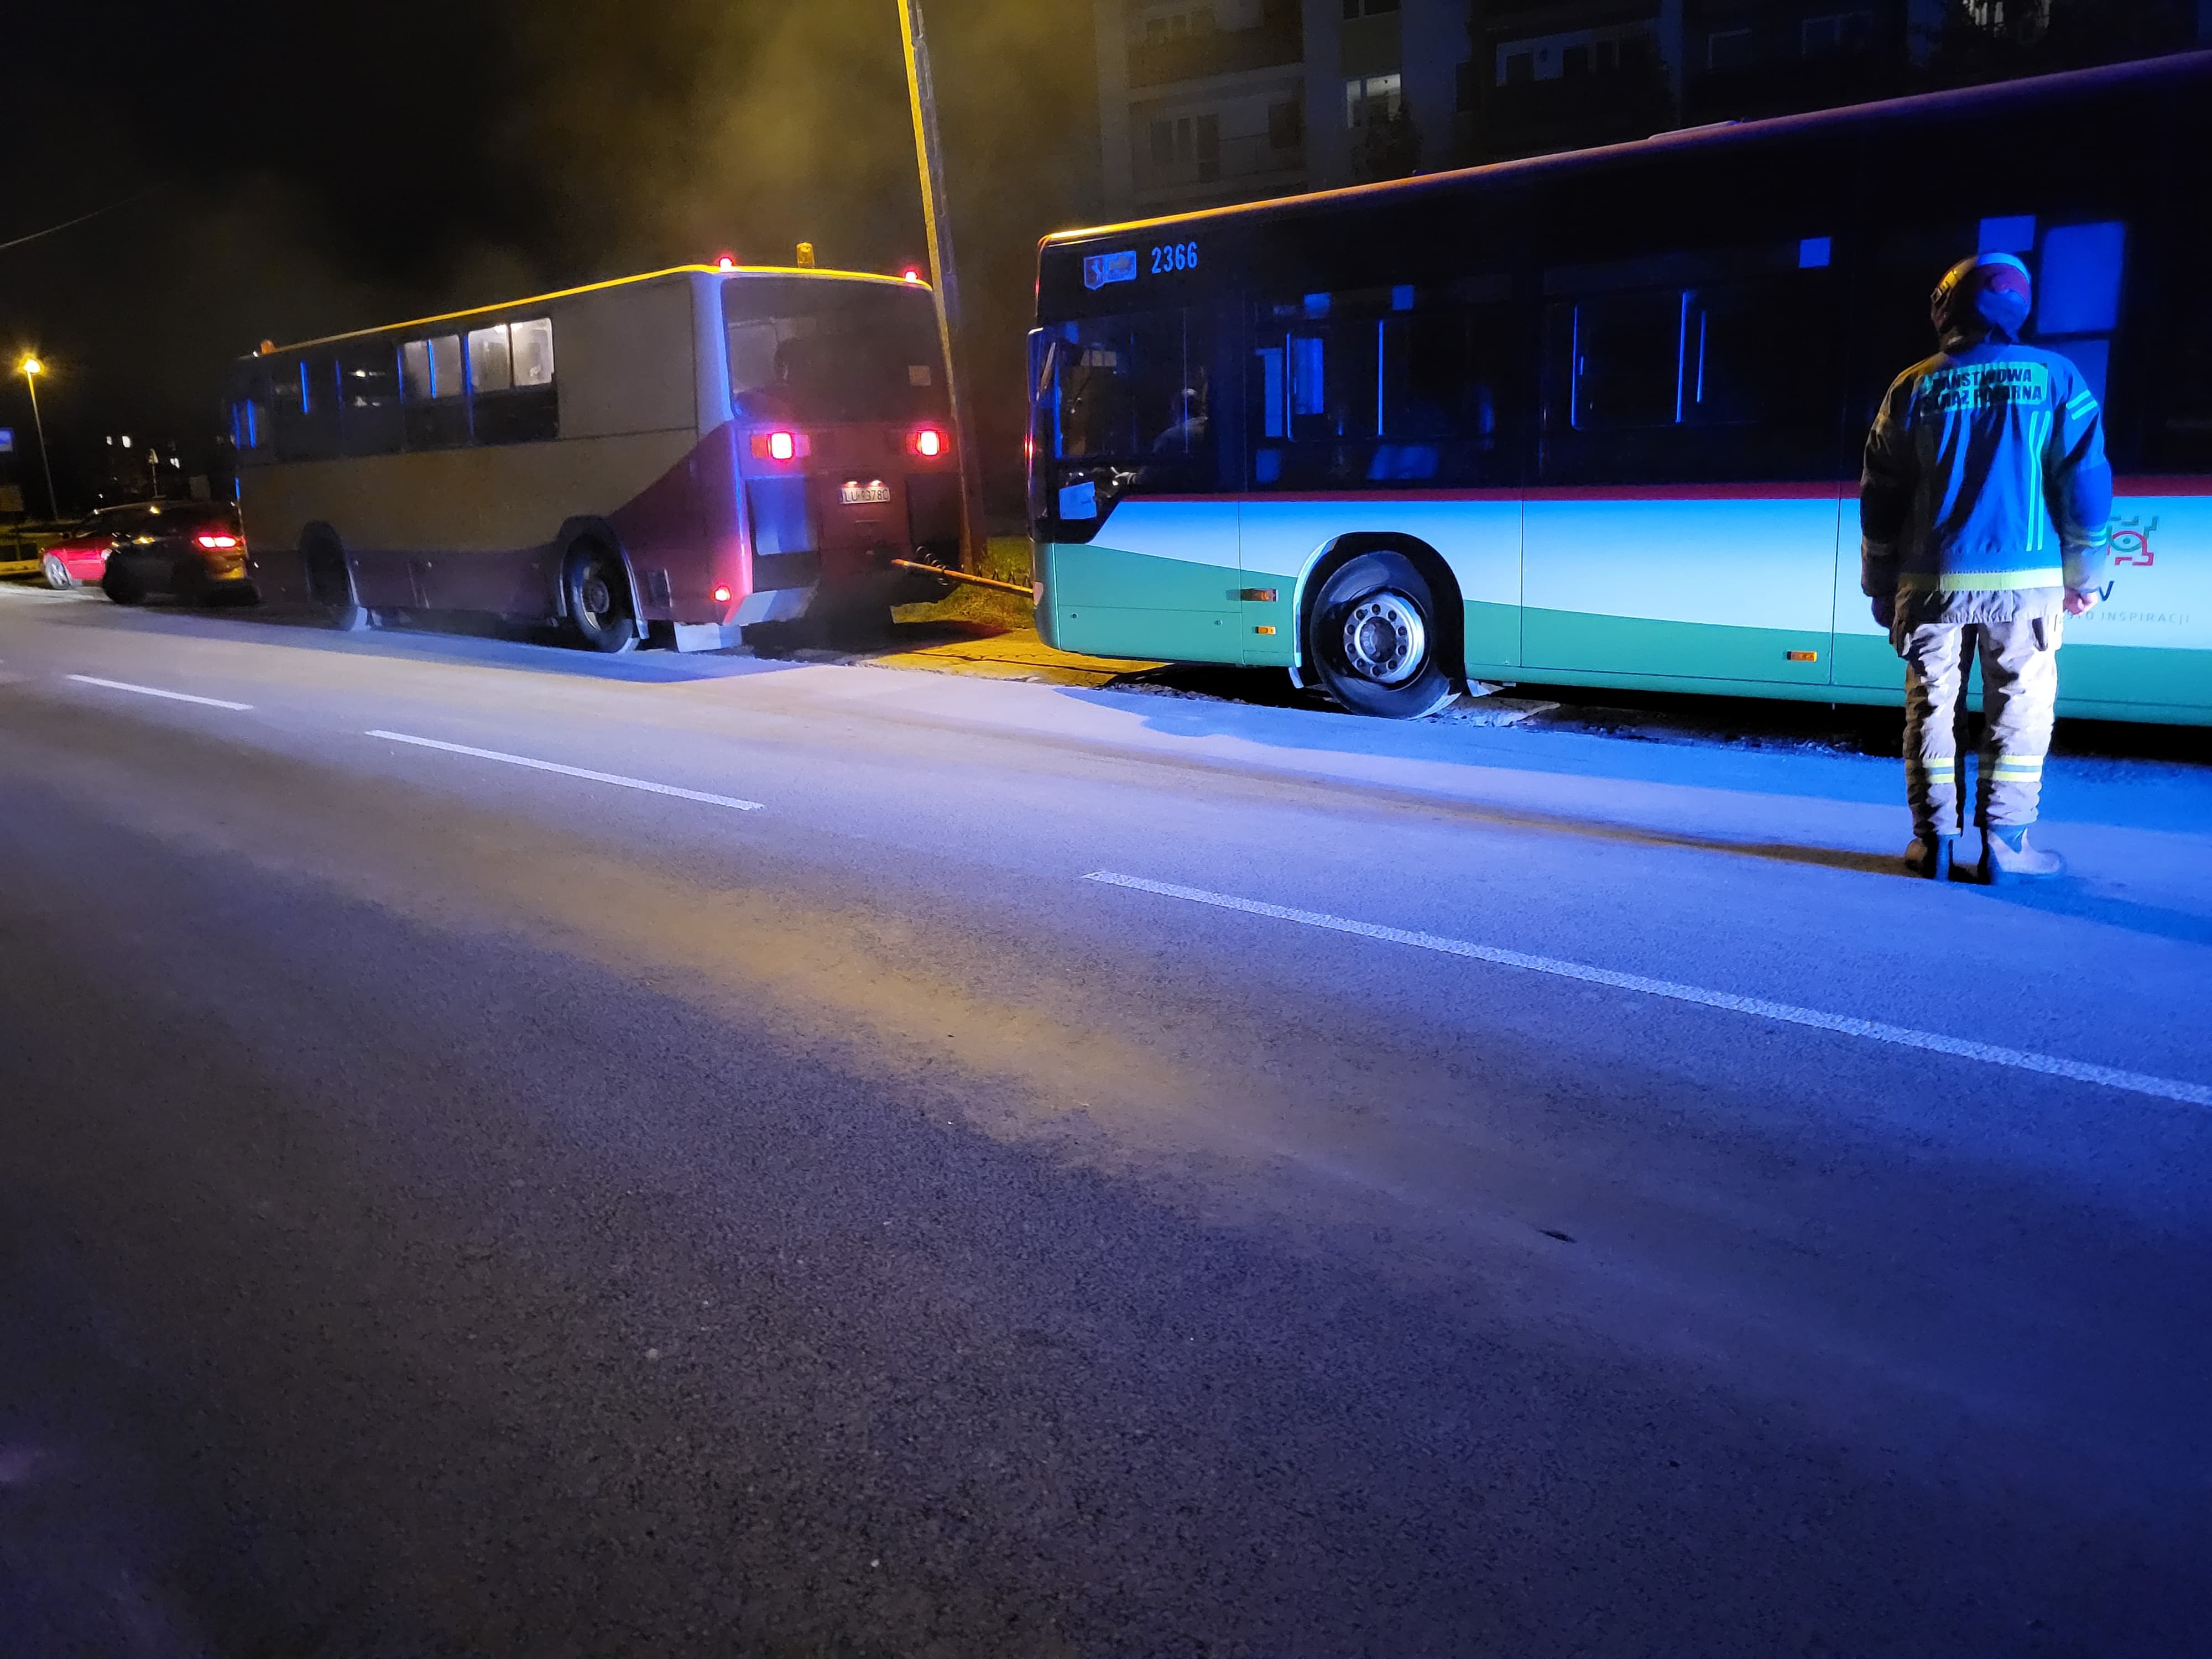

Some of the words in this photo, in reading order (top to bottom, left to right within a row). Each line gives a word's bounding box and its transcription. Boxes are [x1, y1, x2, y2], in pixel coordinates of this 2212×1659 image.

[1151, 241, 1198, 274] 2366
[844, 491, 858, 502] LU
[2101, 611, 2189, 625] INSPIRACJI
